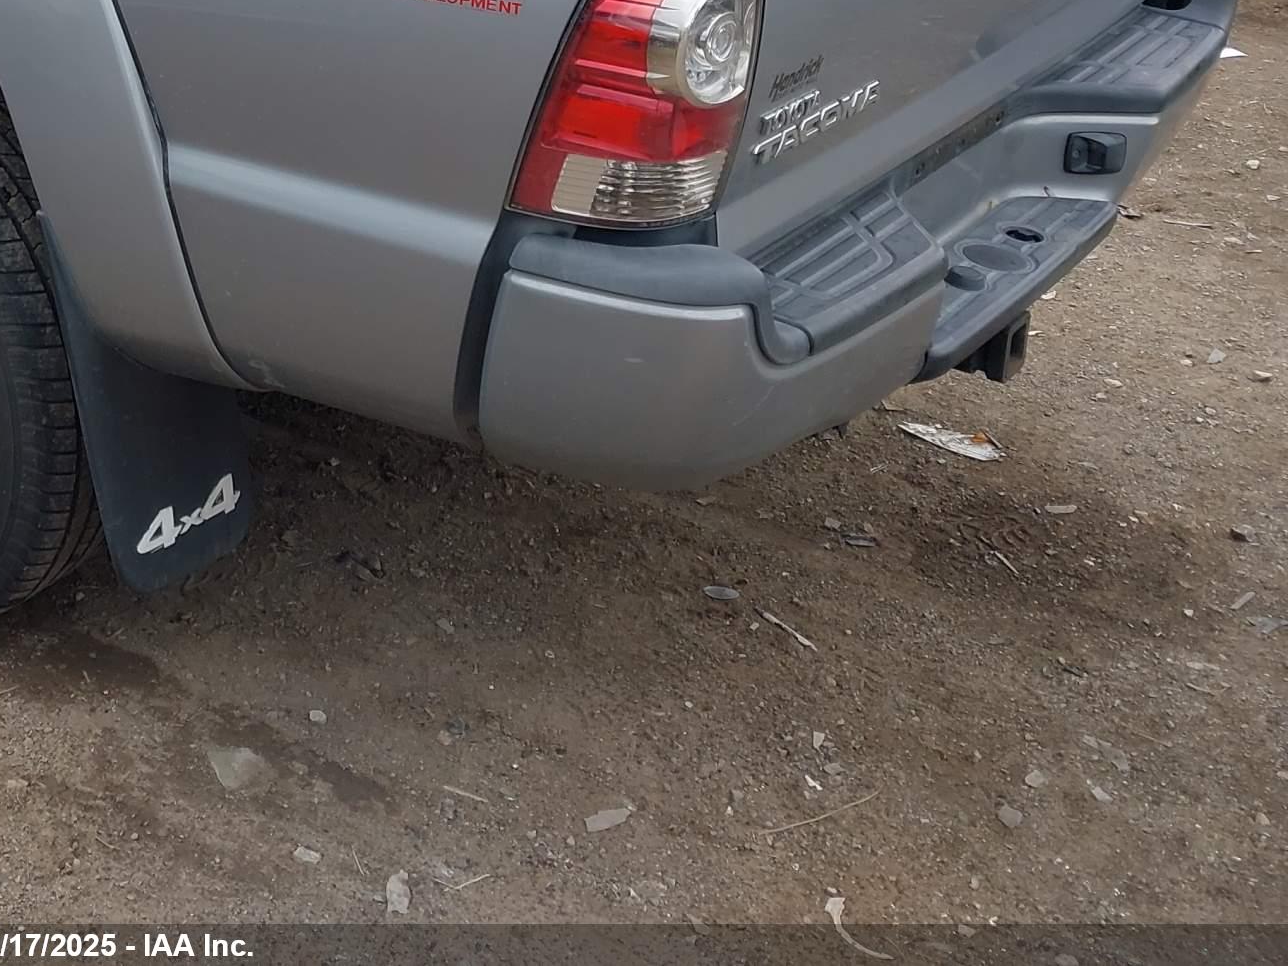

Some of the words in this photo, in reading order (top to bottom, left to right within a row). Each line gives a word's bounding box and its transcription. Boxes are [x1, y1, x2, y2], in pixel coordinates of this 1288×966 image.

[768, 54, 825, 102] Hendrick
[752, 79, 881, 164] TACOMA
[759, 89, 821, 135] TOYOTA
[136, 472, 241, 555] 4x4
